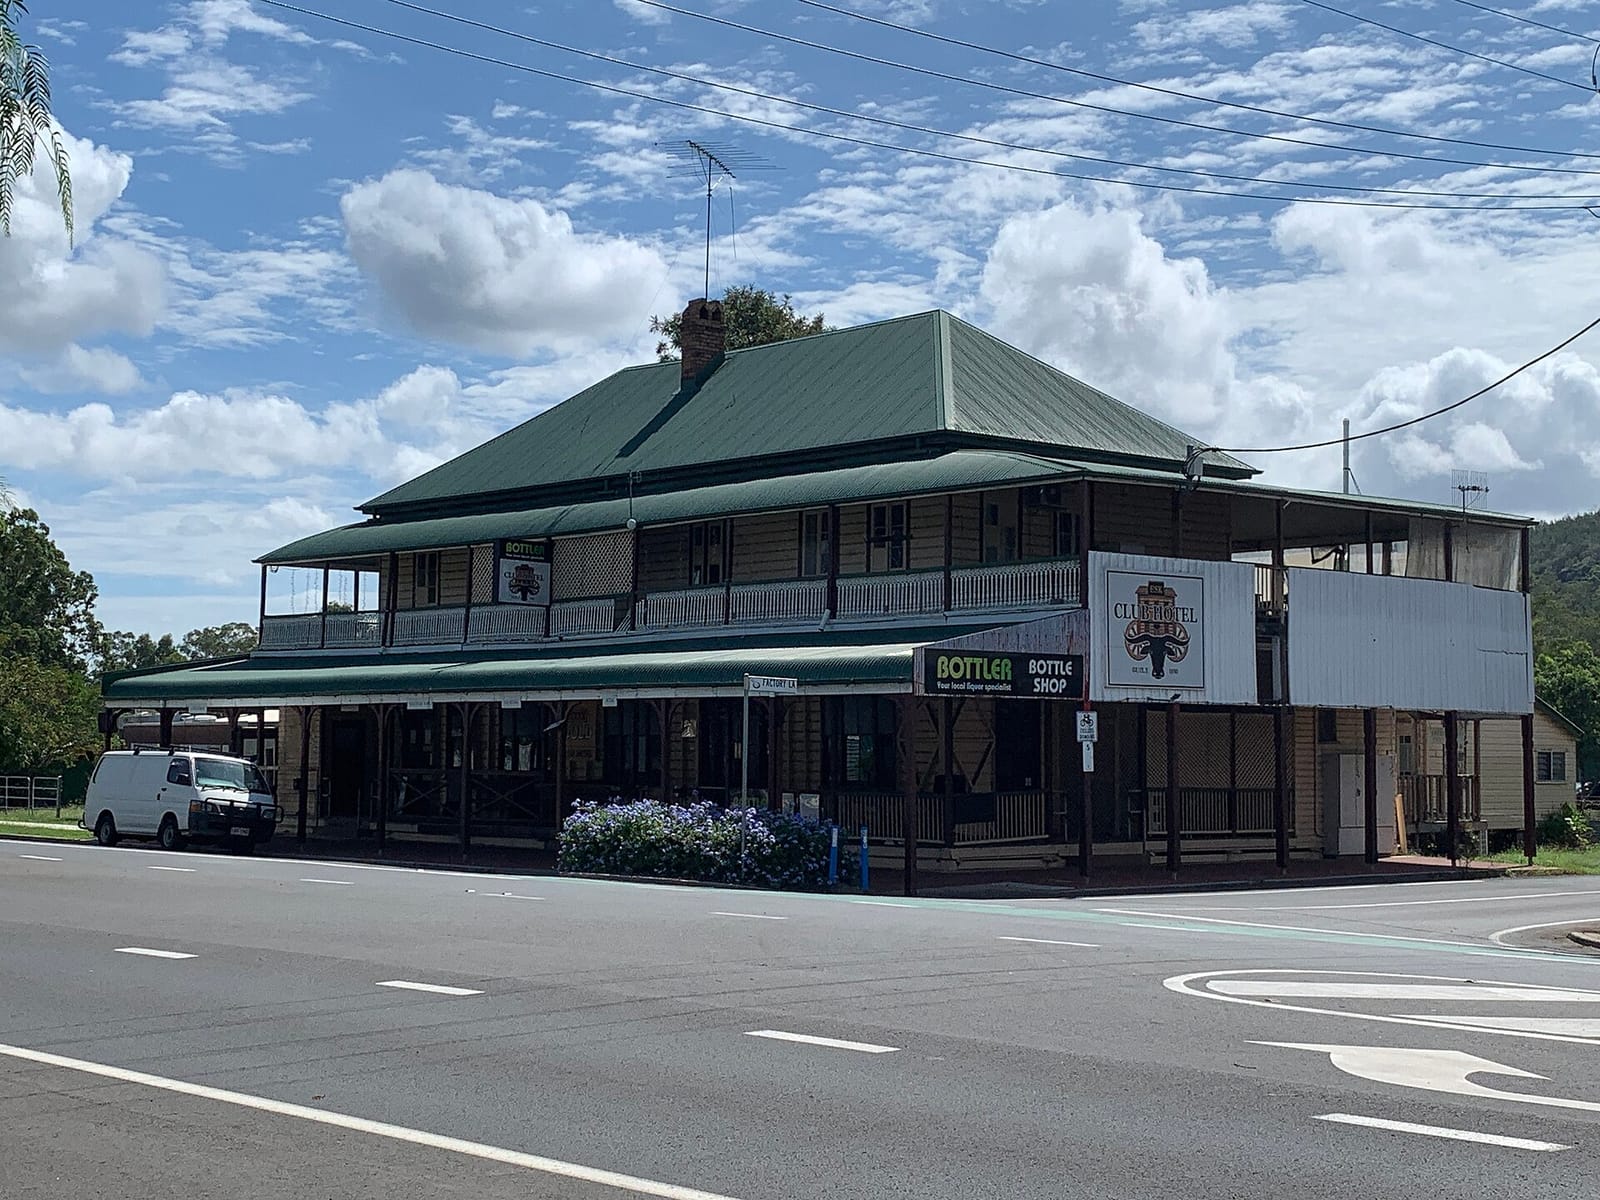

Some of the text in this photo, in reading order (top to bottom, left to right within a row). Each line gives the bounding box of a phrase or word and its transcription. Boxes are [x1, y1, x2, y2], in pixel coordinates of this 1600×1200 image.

[506, 542, 545, 554] BOTTLER
[1114, 602, 1198, 623] CLUB HOTEL
[936, 655, 1013, 681] BOTTLER
[1028, 658, 1073, 676] BOTTLE
[762, 679, 796, 689] FACTORY LA
[936, 680, 1012, 692] Your local liquor specialist
[1033, 677, 1067, 694] SHOP
